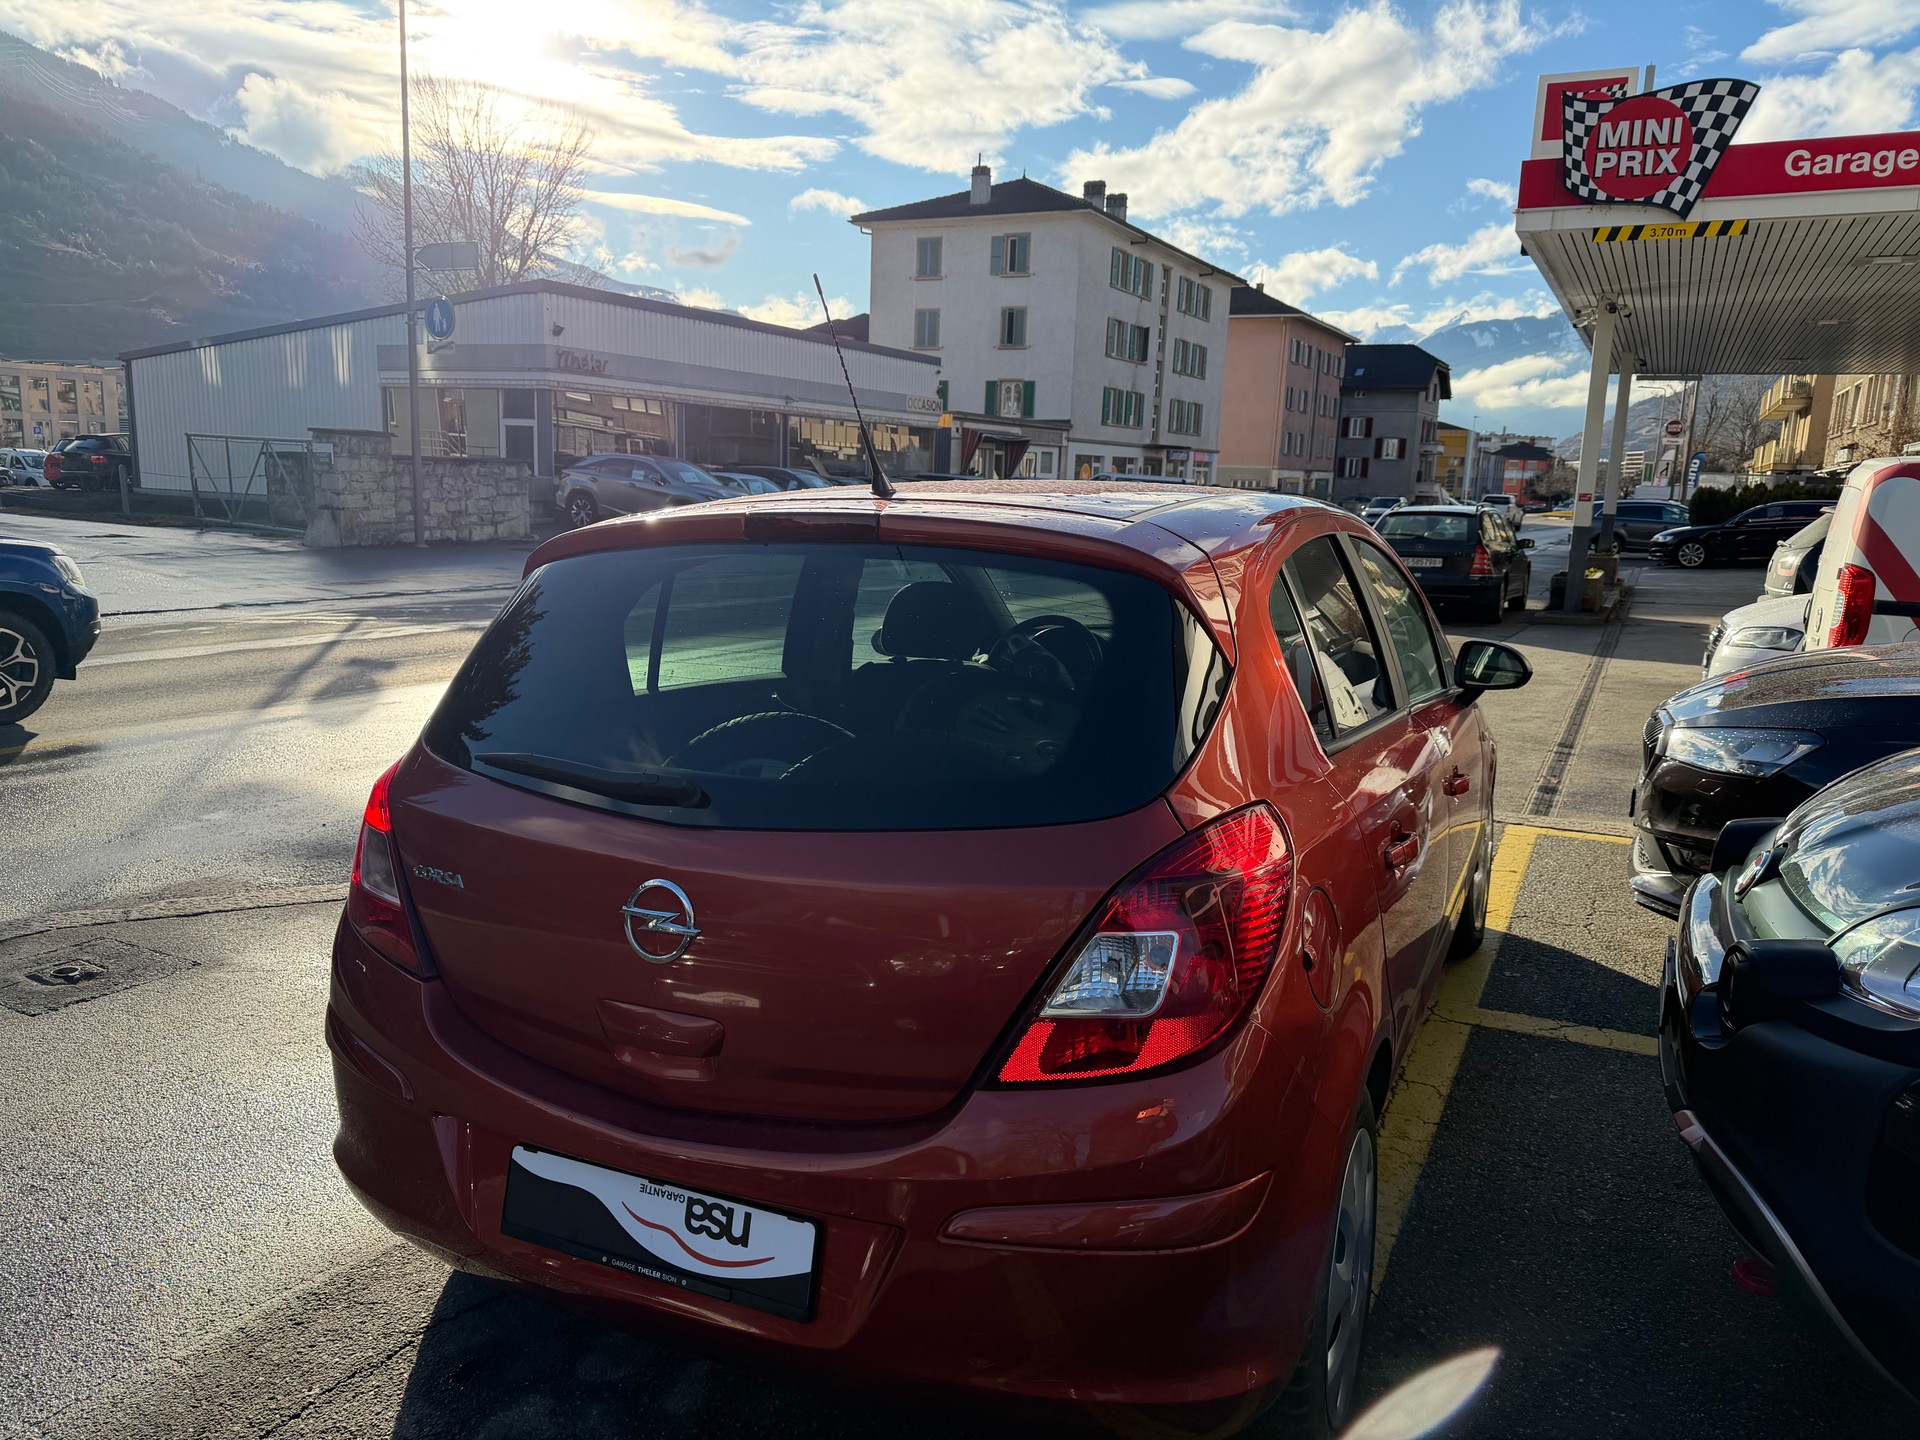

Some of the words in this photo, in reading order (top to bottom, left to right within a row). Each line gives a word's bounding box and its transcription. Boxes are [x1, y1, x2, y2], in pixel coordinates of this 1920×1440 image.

[1597, 116, 1684, 149] MINI
[1594, 147, 1682, 179] PRIX
[1784, 148, 1919, 178] Garage
[907, 397, 942, 412] OCCASION
[413, 864, 465, 888] CORSA
[639, 1183, 686, 1204] GARANTIE
[684, 1195, 752, 1248] nsa
[611, 1258, 637, 1272] GARAGE
[637, 1266, 661, 1279] THELER
[662, 1273, 678, 1284] SION
